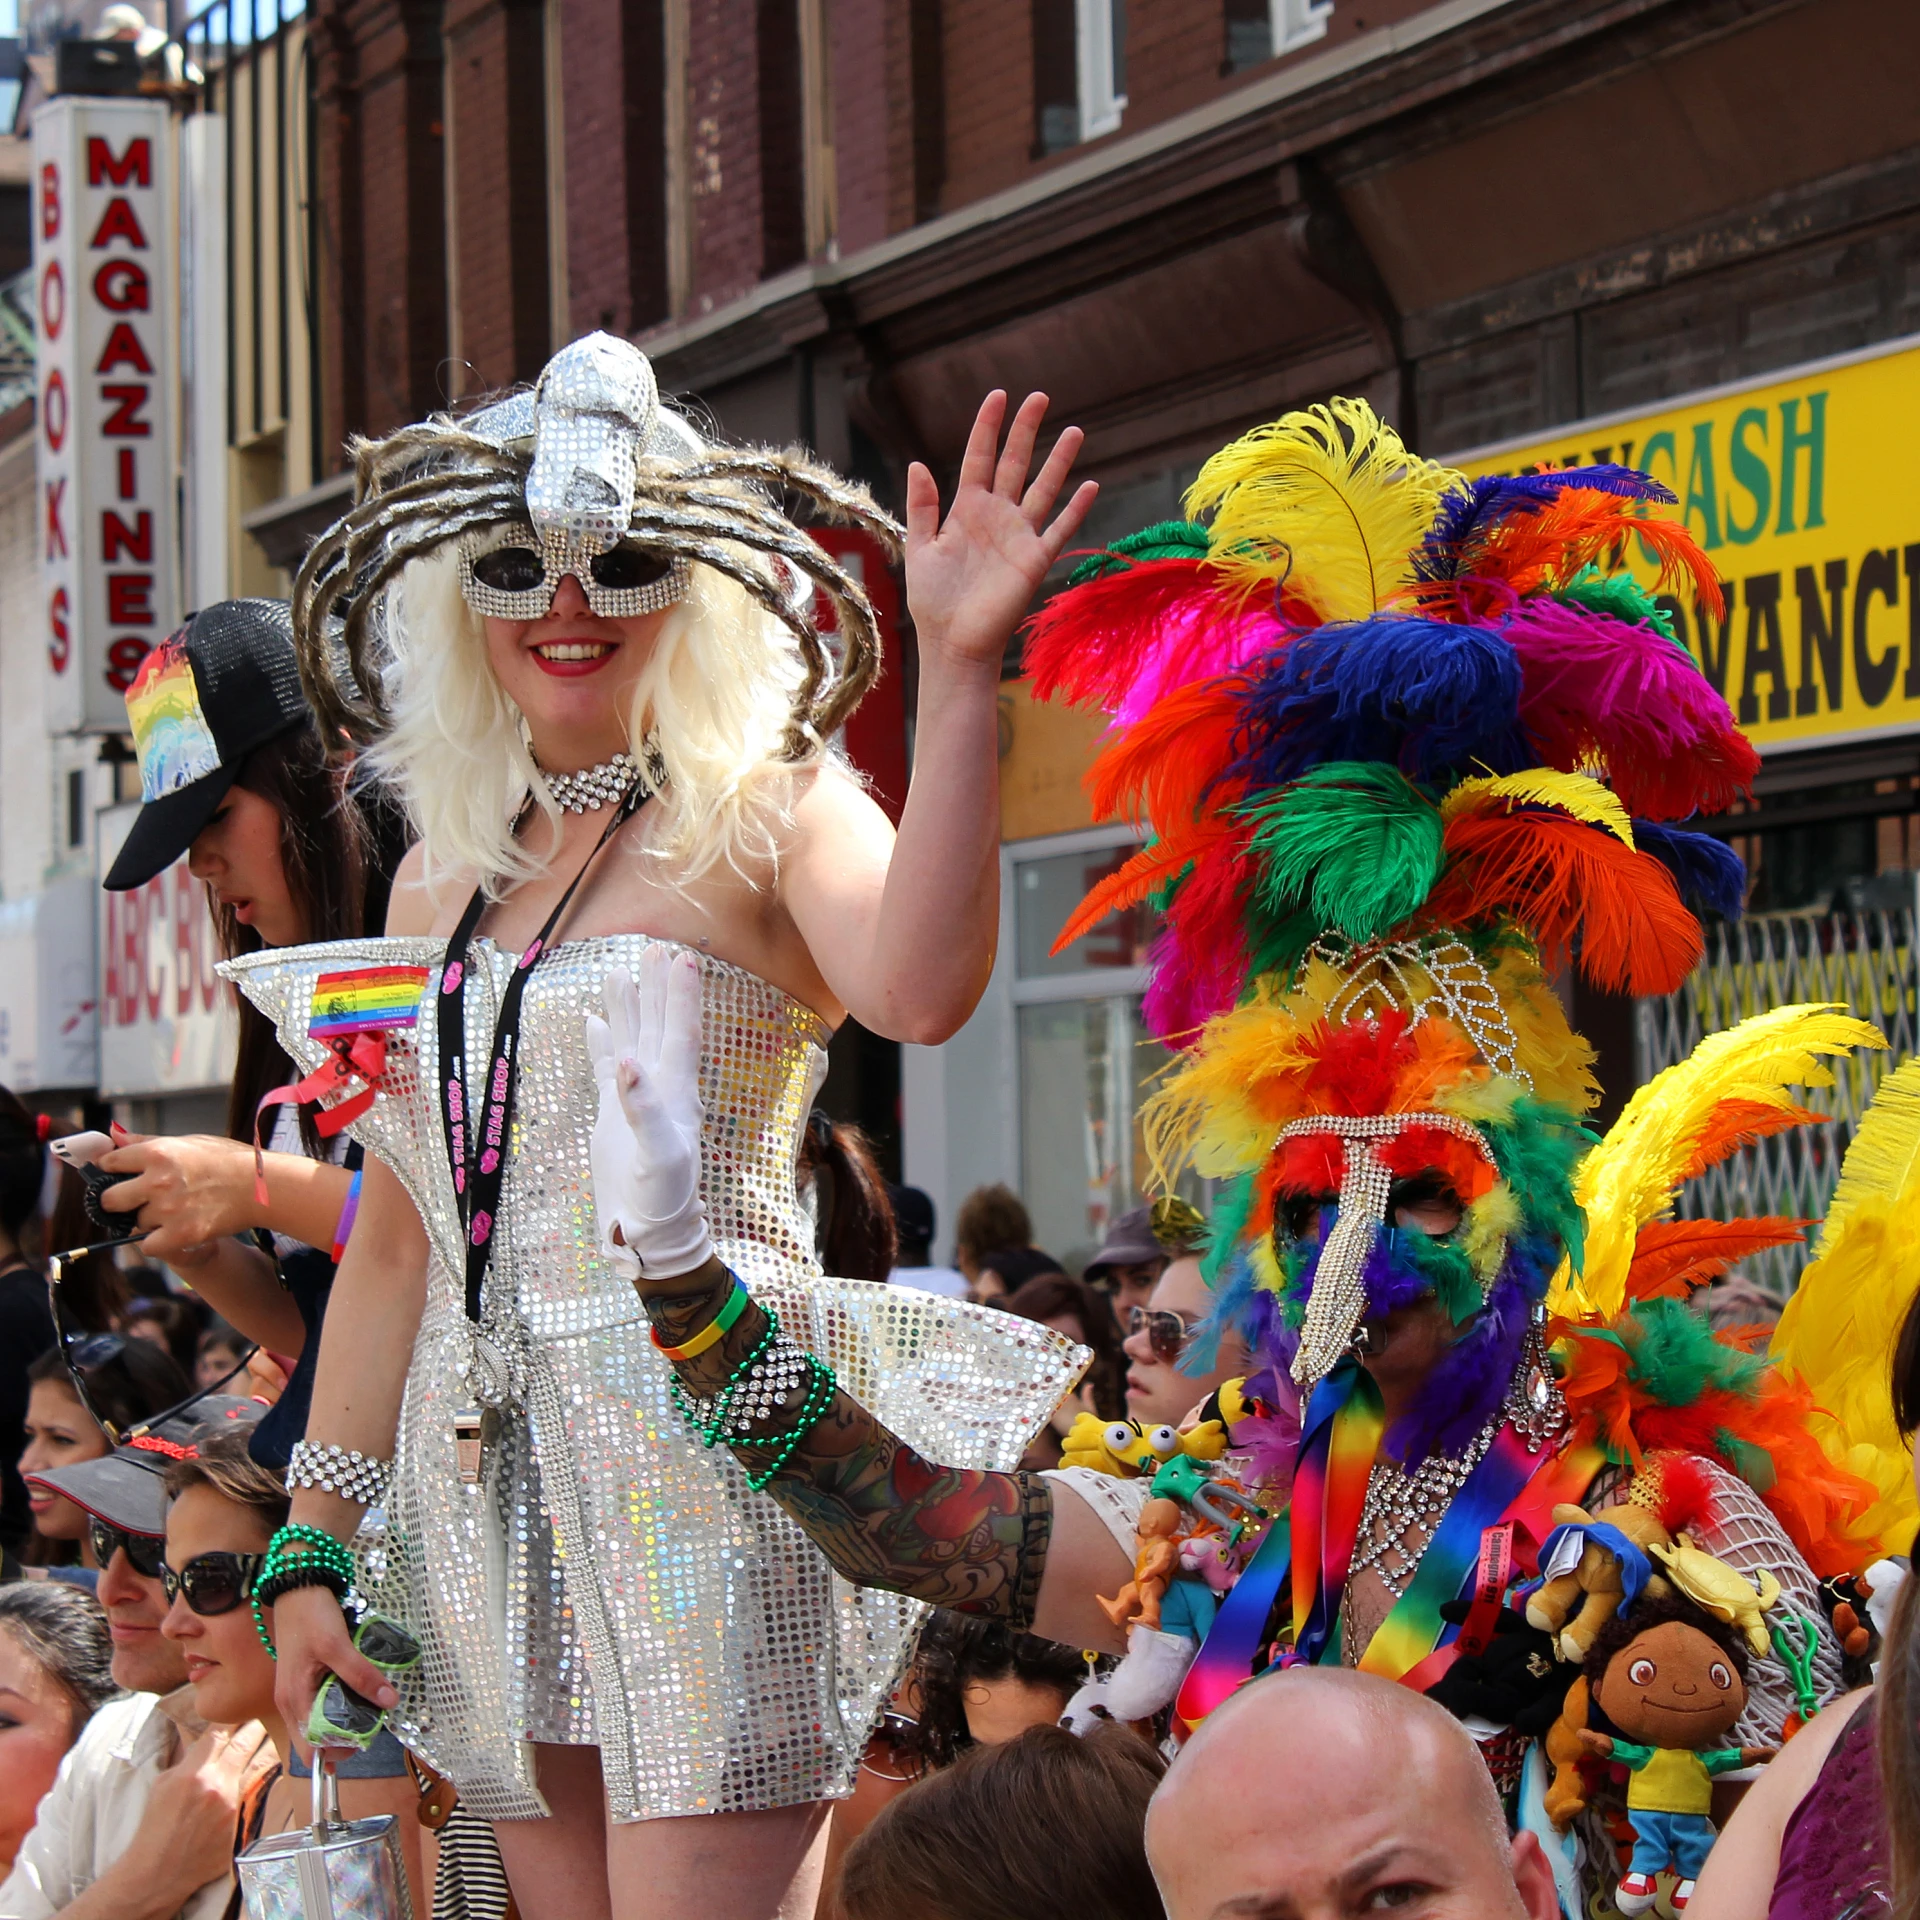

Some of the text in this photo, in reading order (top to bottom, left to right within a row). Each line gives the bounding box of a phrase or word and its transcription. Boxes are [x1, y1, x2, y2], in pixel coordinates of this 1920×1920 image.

[41, 160, 70, 677] BOOKS
[87, 135, 156, 697] MAGAZINES
[451, 1123, 465, 1166] STAG
[486, 1104, 505, 1147] STAG
